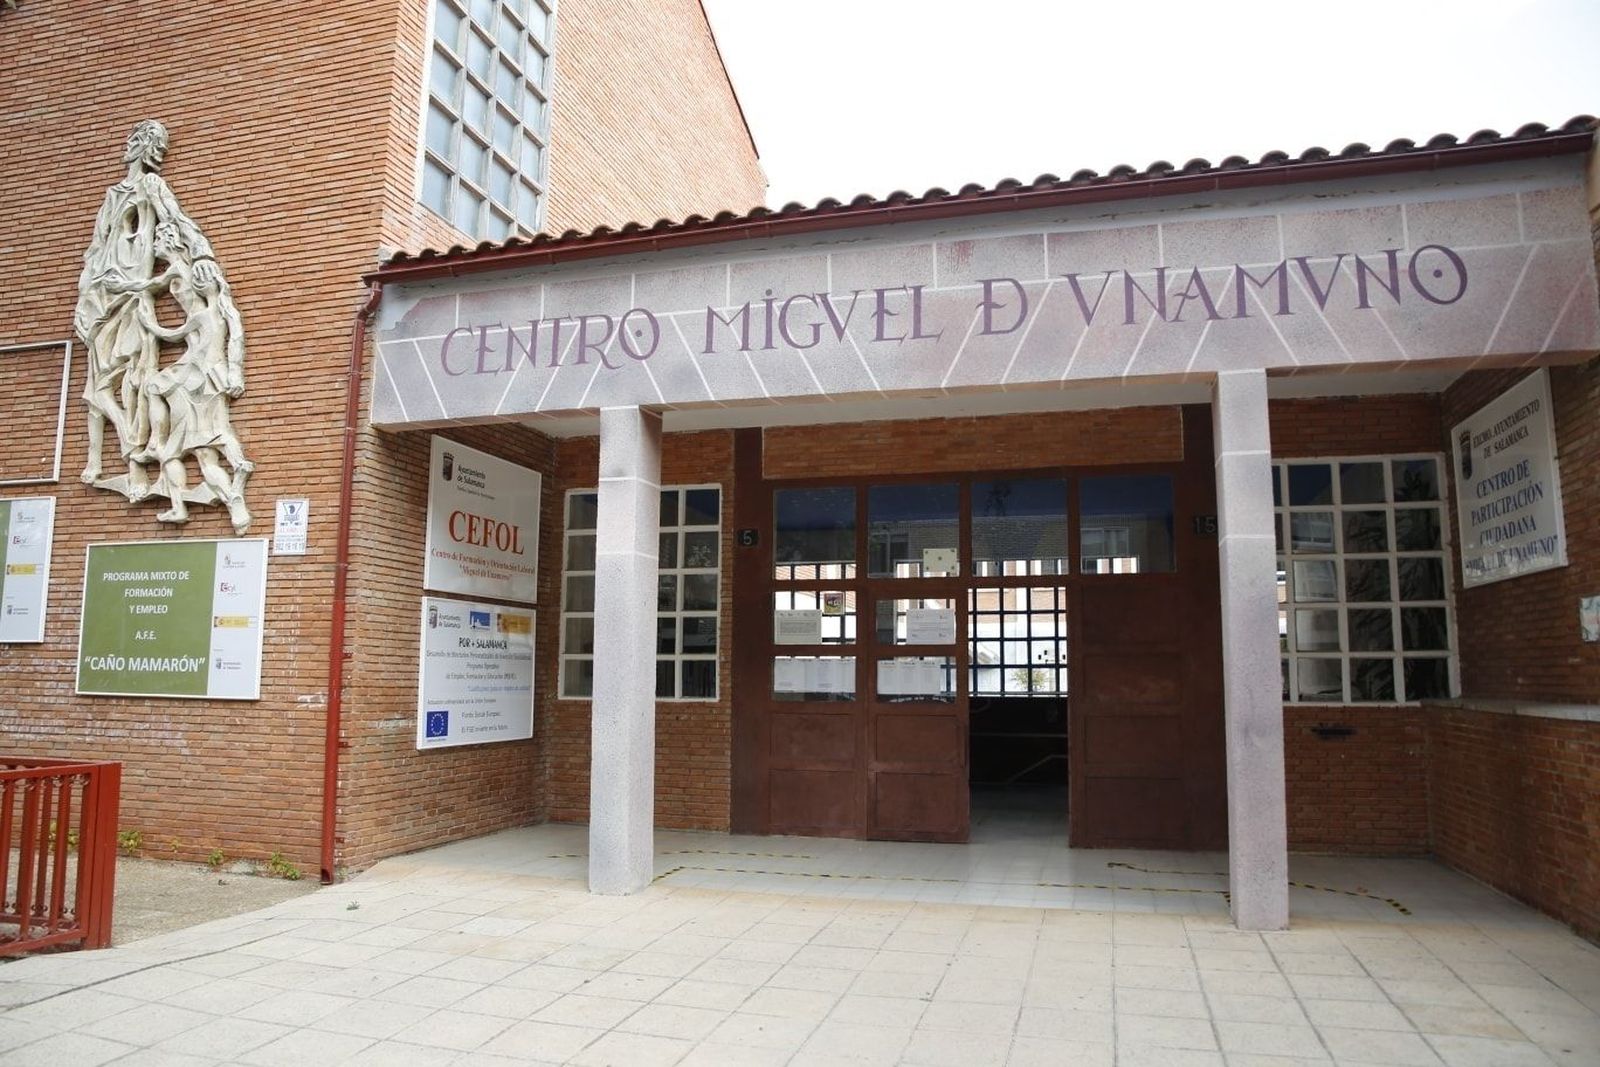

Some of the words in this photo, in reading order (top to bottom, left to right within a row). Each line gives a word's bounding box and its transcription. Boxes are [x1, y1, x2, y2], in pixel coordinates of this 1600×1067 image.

[441, 308, 660, 377] CENTRO
[1484, 446, 1491, 459] DE
[1494, 425, 1529, 455] SALAMANCA
[1477, 467, 1515, 498] CENTRO
[1517, 459, 1530, 481] DE
[1471, 480, 1544, 527] PARTICIPACIÓN
[449, 510, 524, 555] CEFOL
[742, 529, 753, 546] 5
[1480, 514, 1537, 545] CIUDADANA
[431, 547, 450, 560] Centro
[517, 563, 535, 575] Laboral
[103, 572, 149, 582] PROGRAMA
[150, 571, 177, 581] MIXTO
[178, 571, 190, 580] DE
[125, 586, 173, 598] FORMACIÓN
[129, 605, 135, 614] Y
[136, 604, 168, 614] EMPLEO
[135, 630, 157, 640] A.F.E.
[476, 639, 508, 650] SALAMANCA
